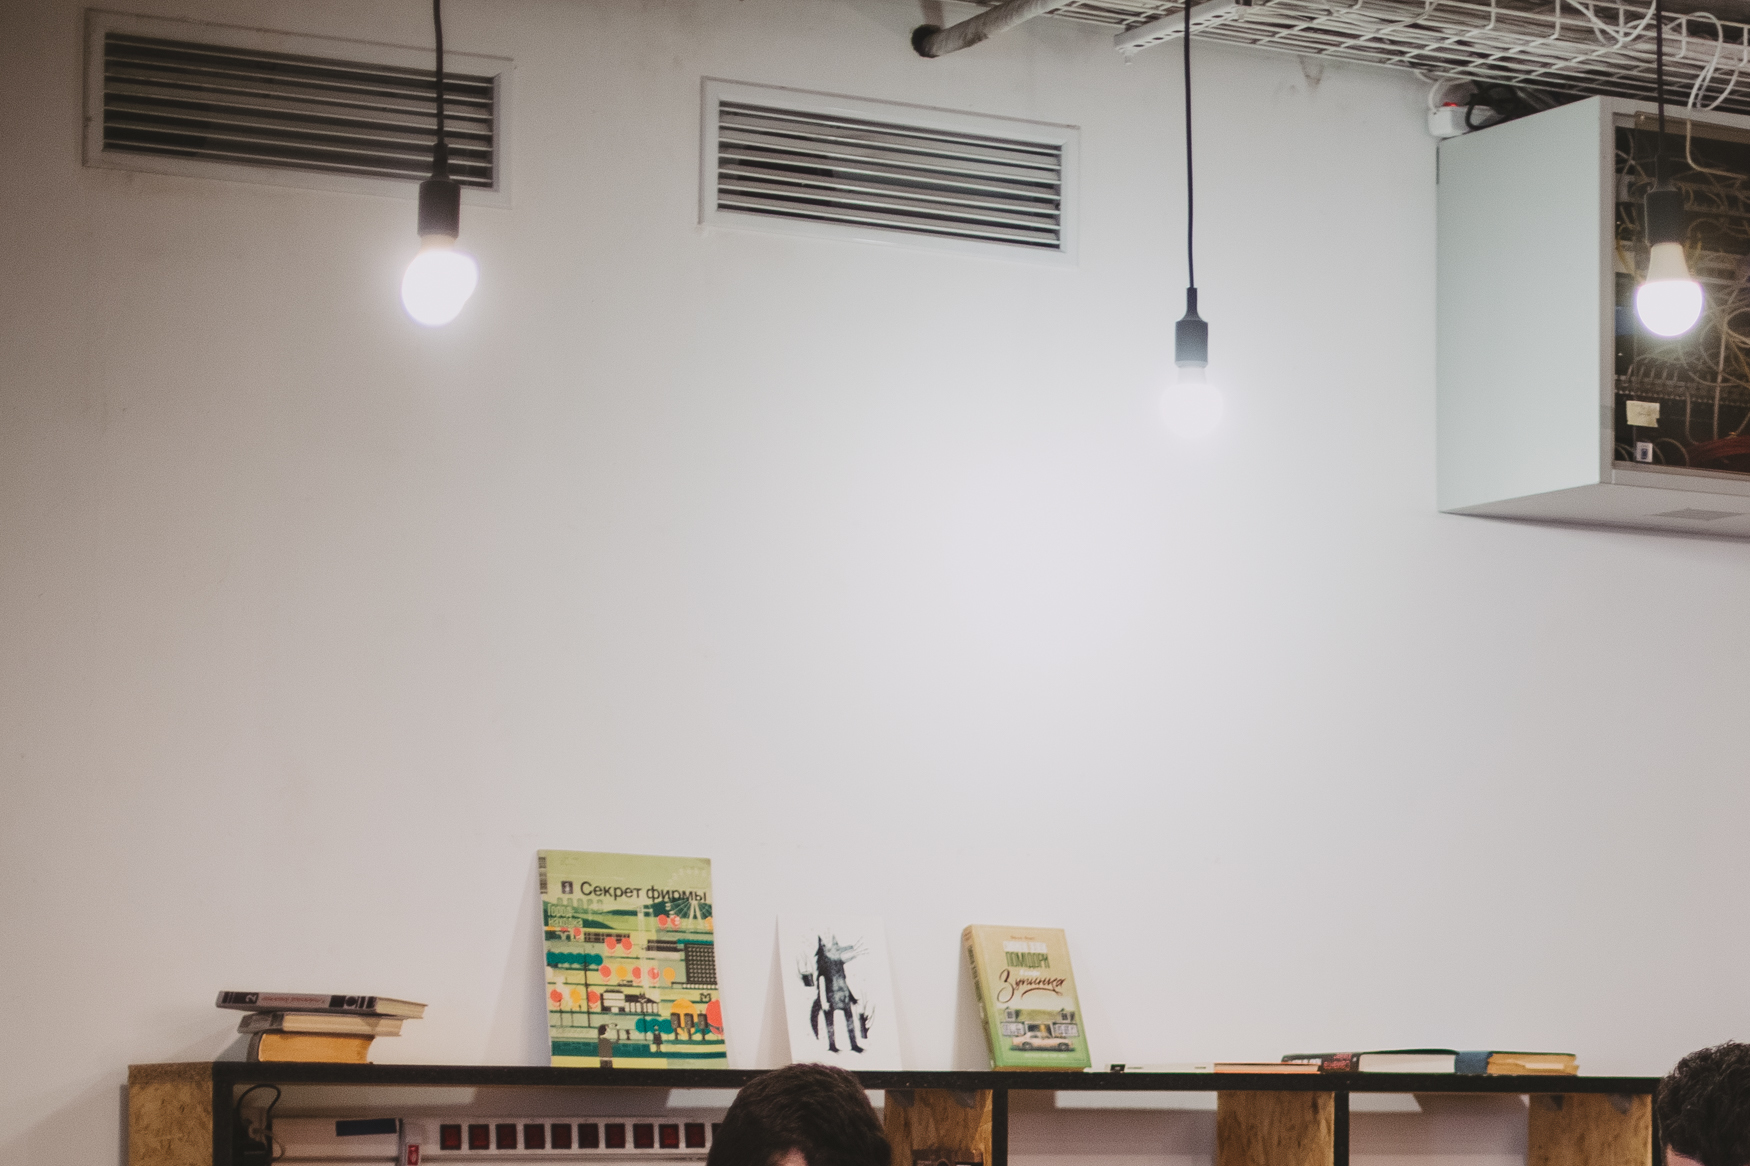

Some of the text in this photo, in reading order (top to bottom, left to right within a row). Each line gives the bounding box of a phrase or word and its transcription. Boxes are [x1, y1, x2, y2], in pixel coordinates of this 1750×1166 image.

[580, 881, 707, 902] Секрет фирмы
[1005, 951, 1050, 969] ПОМІДОРИ
[997, 968, 1067, 1004] Зупинка
